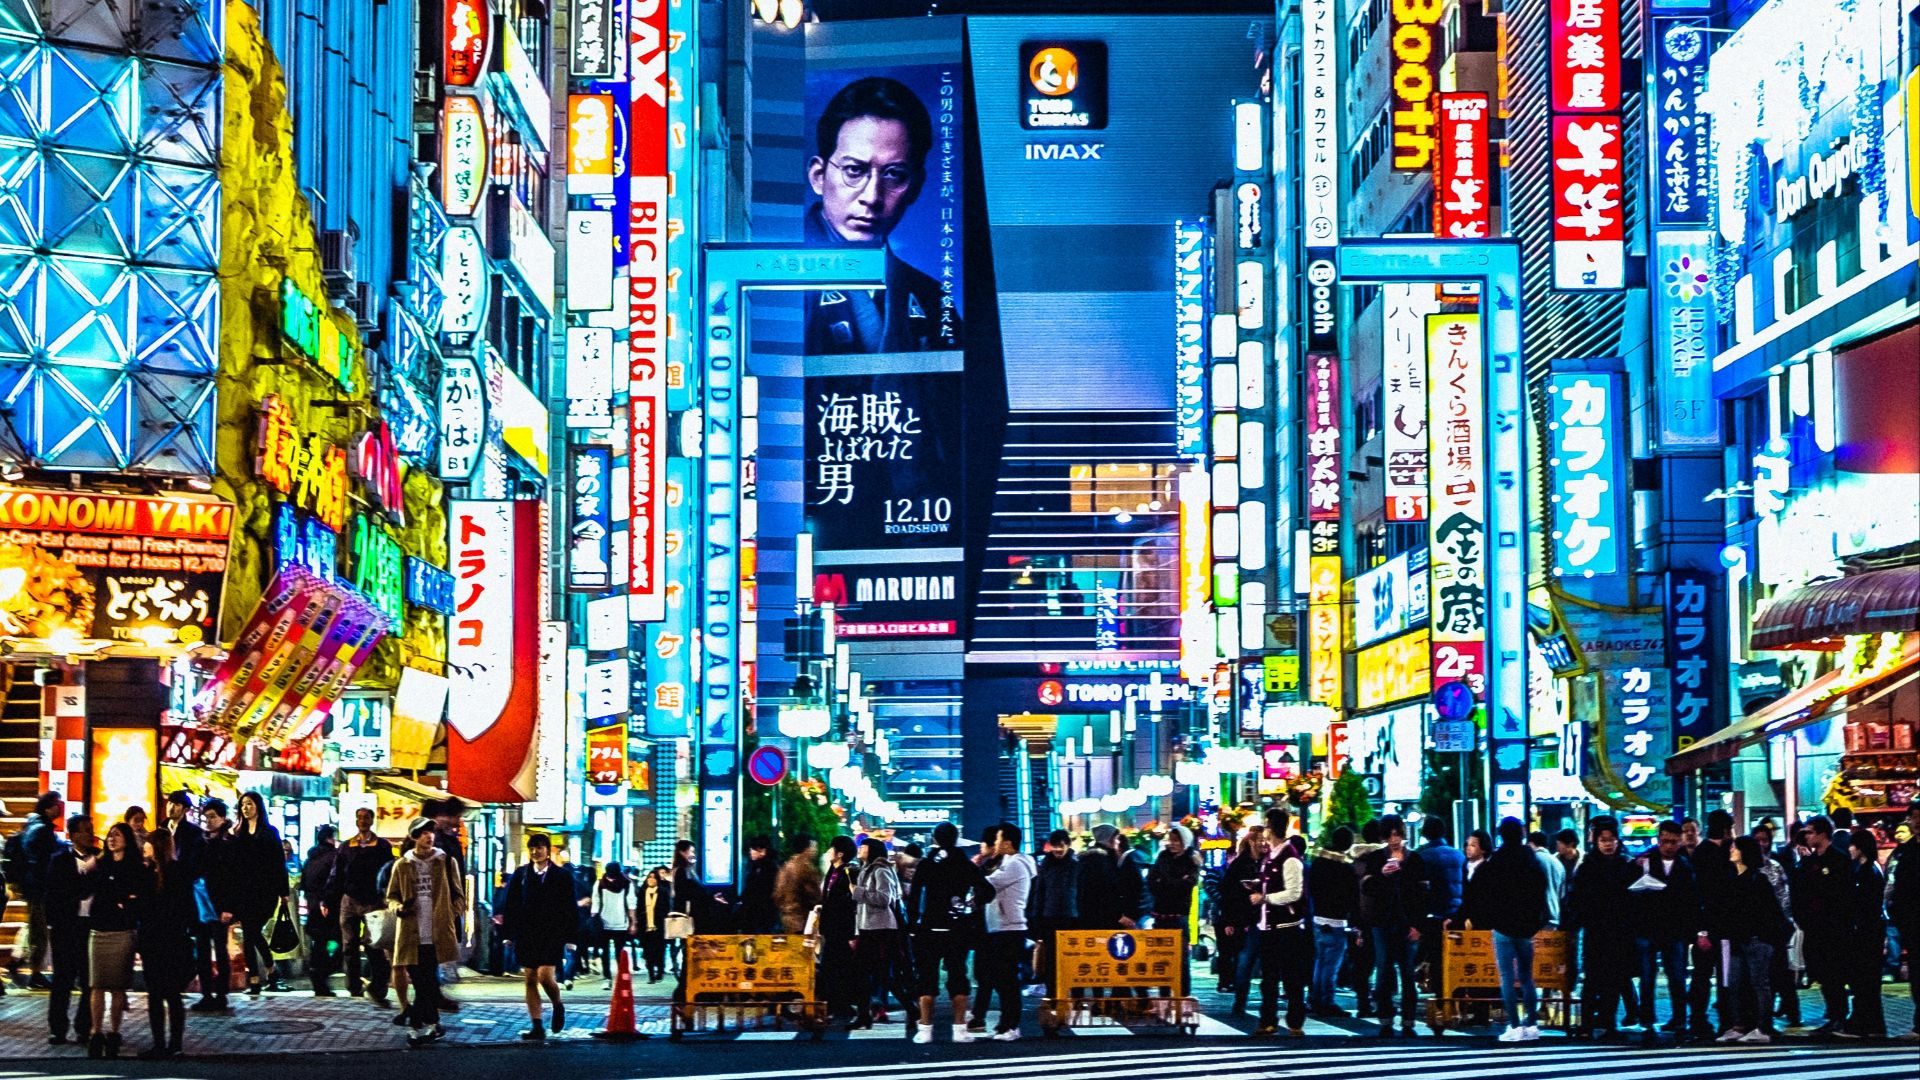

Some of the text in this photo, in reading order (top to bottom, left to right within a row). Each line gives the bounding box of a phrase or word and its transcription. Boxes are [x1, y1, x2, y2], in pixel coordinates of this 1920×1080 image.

[1025, 144, 1101, 160] IMAX
[630, 201, 657, 381] BIC DRUG
[817, 391, 922, 436] 海賊と
[1447, 324, 1473, 471] きんくら酒場
[816, 464, 855, 505] 男
[817, 436, 913, 462] よばれた
[1561, 380, 1611, 566] カラオケ
[148, 501, 231, 536] YAKI
[708, 325, 732, 699] GODZILLA ROAD
[884, 497, 951, 523] 12.10
[885, 523, 950, 534] ROADSHOW
[457, 515, 486, 647] トラノコ
[857, 576, 955, 601] MARUHAN
[1436, 512, 1486, 634] 金の蔵
[1675, 579, 1709, 727] カラオケ
[1621, 667, 1656, 789] カラオケ
